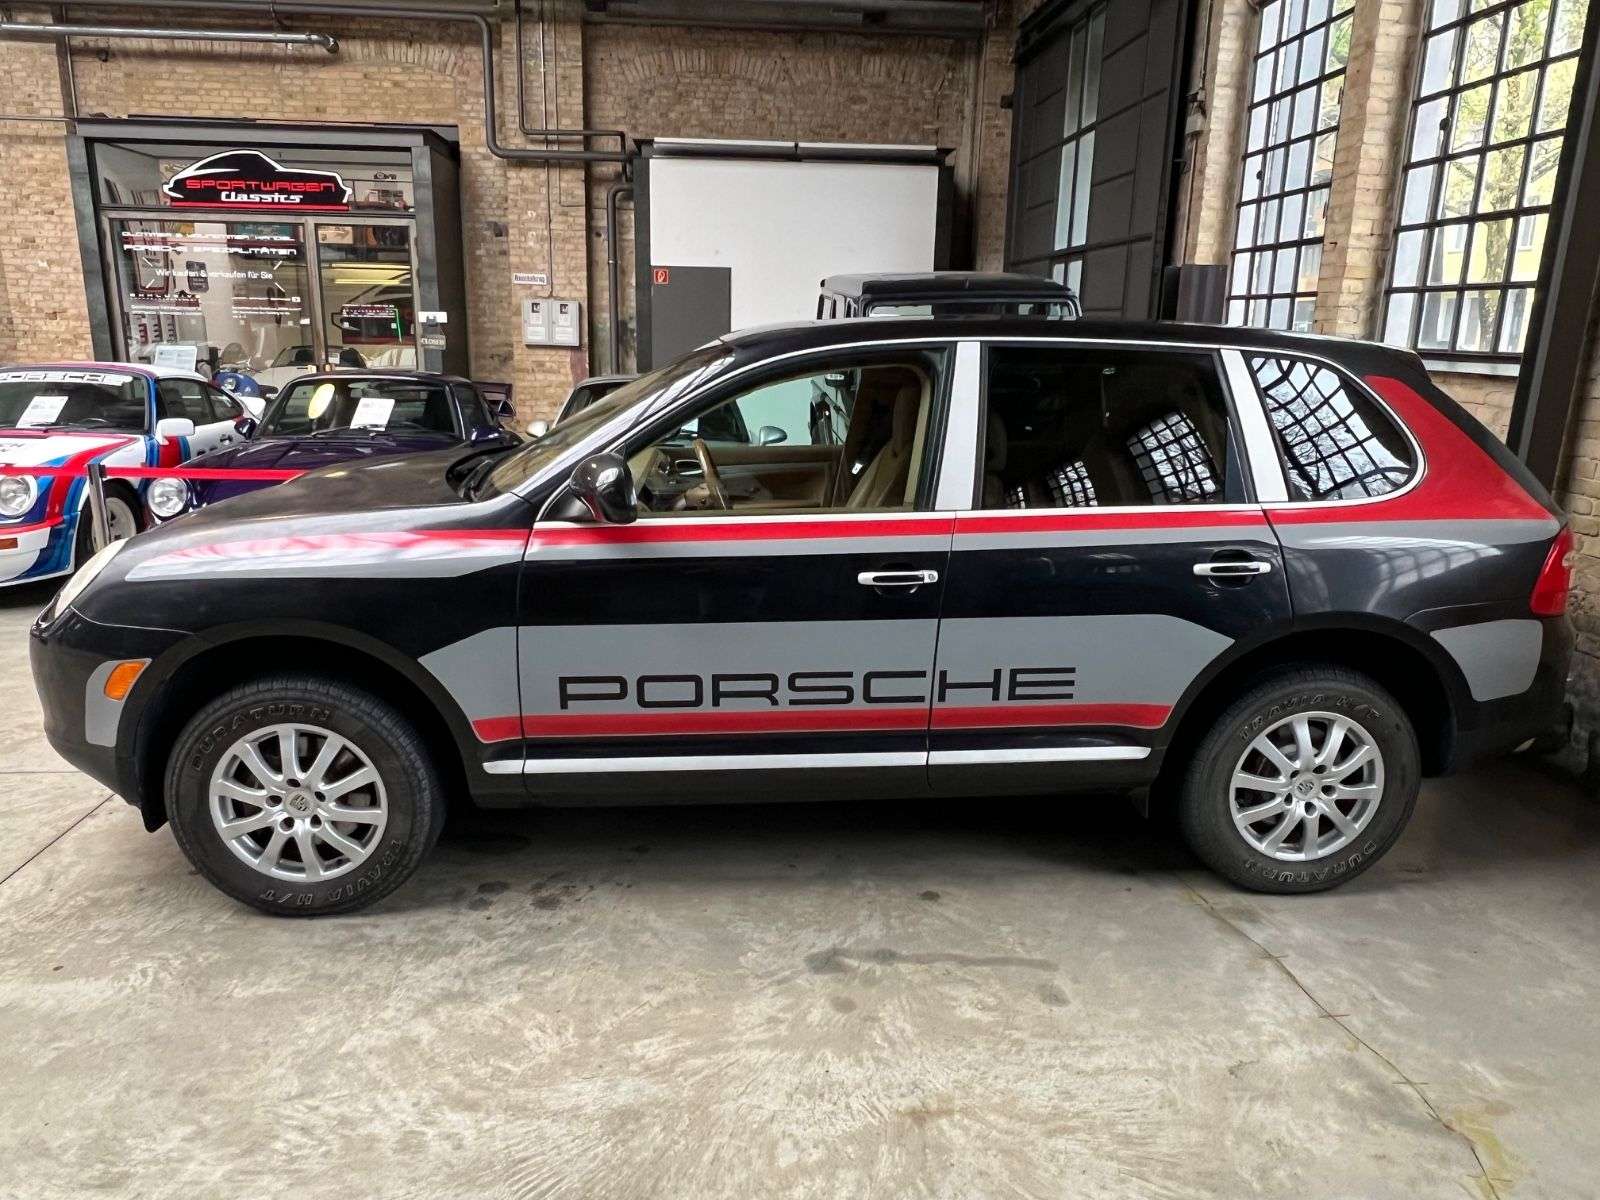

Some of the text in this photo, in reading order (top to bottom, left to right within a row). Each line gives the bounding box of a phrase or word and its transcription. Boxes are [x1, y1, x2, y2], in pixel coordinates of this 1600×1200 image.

[185, 178, 336, 193] SPORTWAGEN
[220, 190, 304, 204] Classics
[172, 269, 199, 277] kaufen
[248, 270, 260, 279] für
[260, 271, 273, 280] Sie
[558, 667, 1076, 710] PORSCHE
